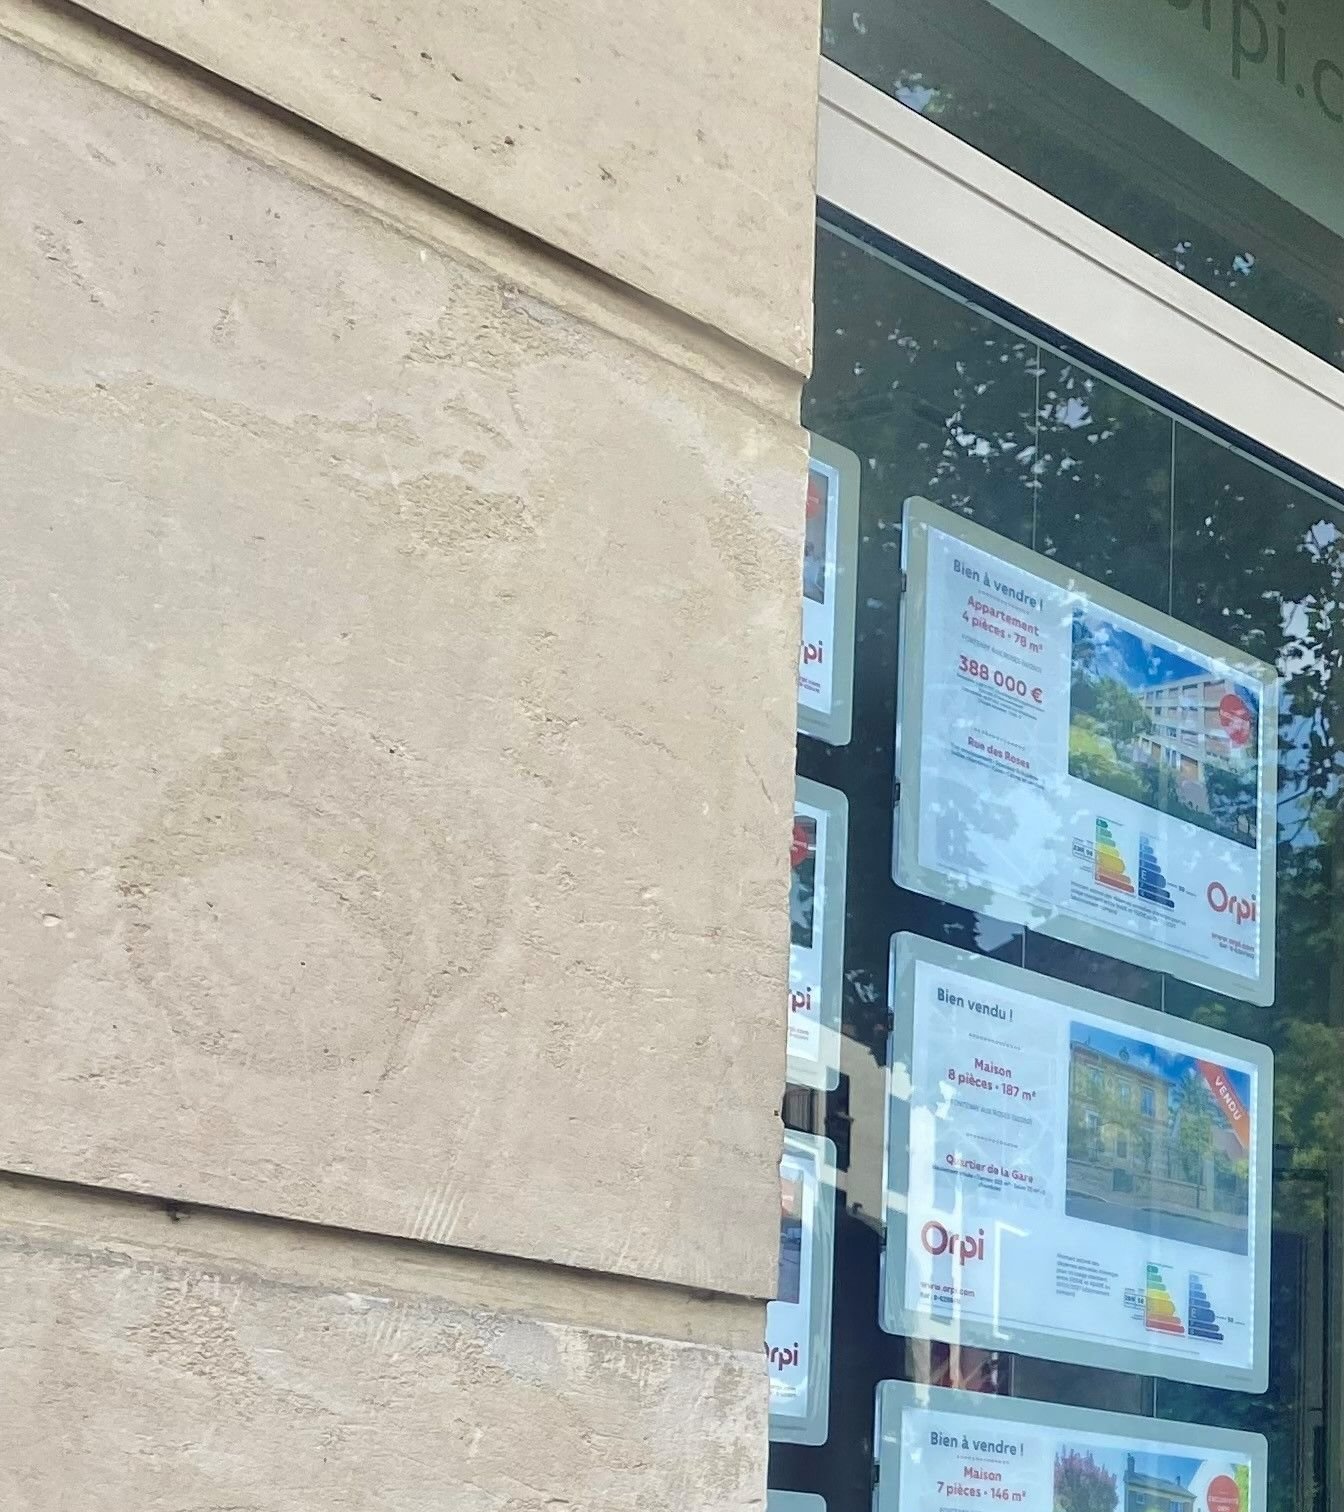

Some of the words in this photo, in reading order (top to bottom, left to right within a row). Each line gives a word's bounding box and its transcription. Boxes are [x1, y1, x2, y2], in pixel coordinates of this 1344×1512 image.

[953, 558, 980, 583] Bien
[982, 570, 991, 588] à
[993, 581, 1037, 609] vendre
[962, 610, 970, 625] 4
[971, 614, 1007, 642] pièces
[1013, 630, 1029, 650] 78
[967, 595, 1040, 637] Appartement
[801, 639, 823, 665] pi
[958, 653, 990, 682] 388
[993, 670, 1028, 698] 000
[1030, 686, 1043, 705] €
[967, 735, 986, 753] Rue
[986, 743, 1004, 762] des
[1004, 750, 1031, 769] Roses
[1206, 880, 1257, 924] Orpi
[789, 986, 812, 1013] pi
[936, 986, 965, 1009] Bien
[967, 997, 1008, 1021] vendu
[948, 1068, 956, 1082] 8
[957, 1072, 993, 1094] pièces
[1001, 1083, 1020, 1099] 187
[974, 1057, 1012, 1080] Maison
[1213, 1074, 1243, 1122] VENDU
[945, 1153, 987, 1173] Qartier
[1000, 1167, 1010, 1178] la
[1011, 1169, 1034, 1184] Gare
[921, 1219, 985, 1266] Orpi
[930, 1431, 959, 1451] Bien
[961, 1436, 970, 1451] à
[973, 1436, 1017, 1456] vendre
[963, 1464, 1003, 1483] Maison
[936, 1481, 945, 1495] 7
[946, 1482, 982, 1500] pièces
[990, 1487, 1009, 1501] 146
